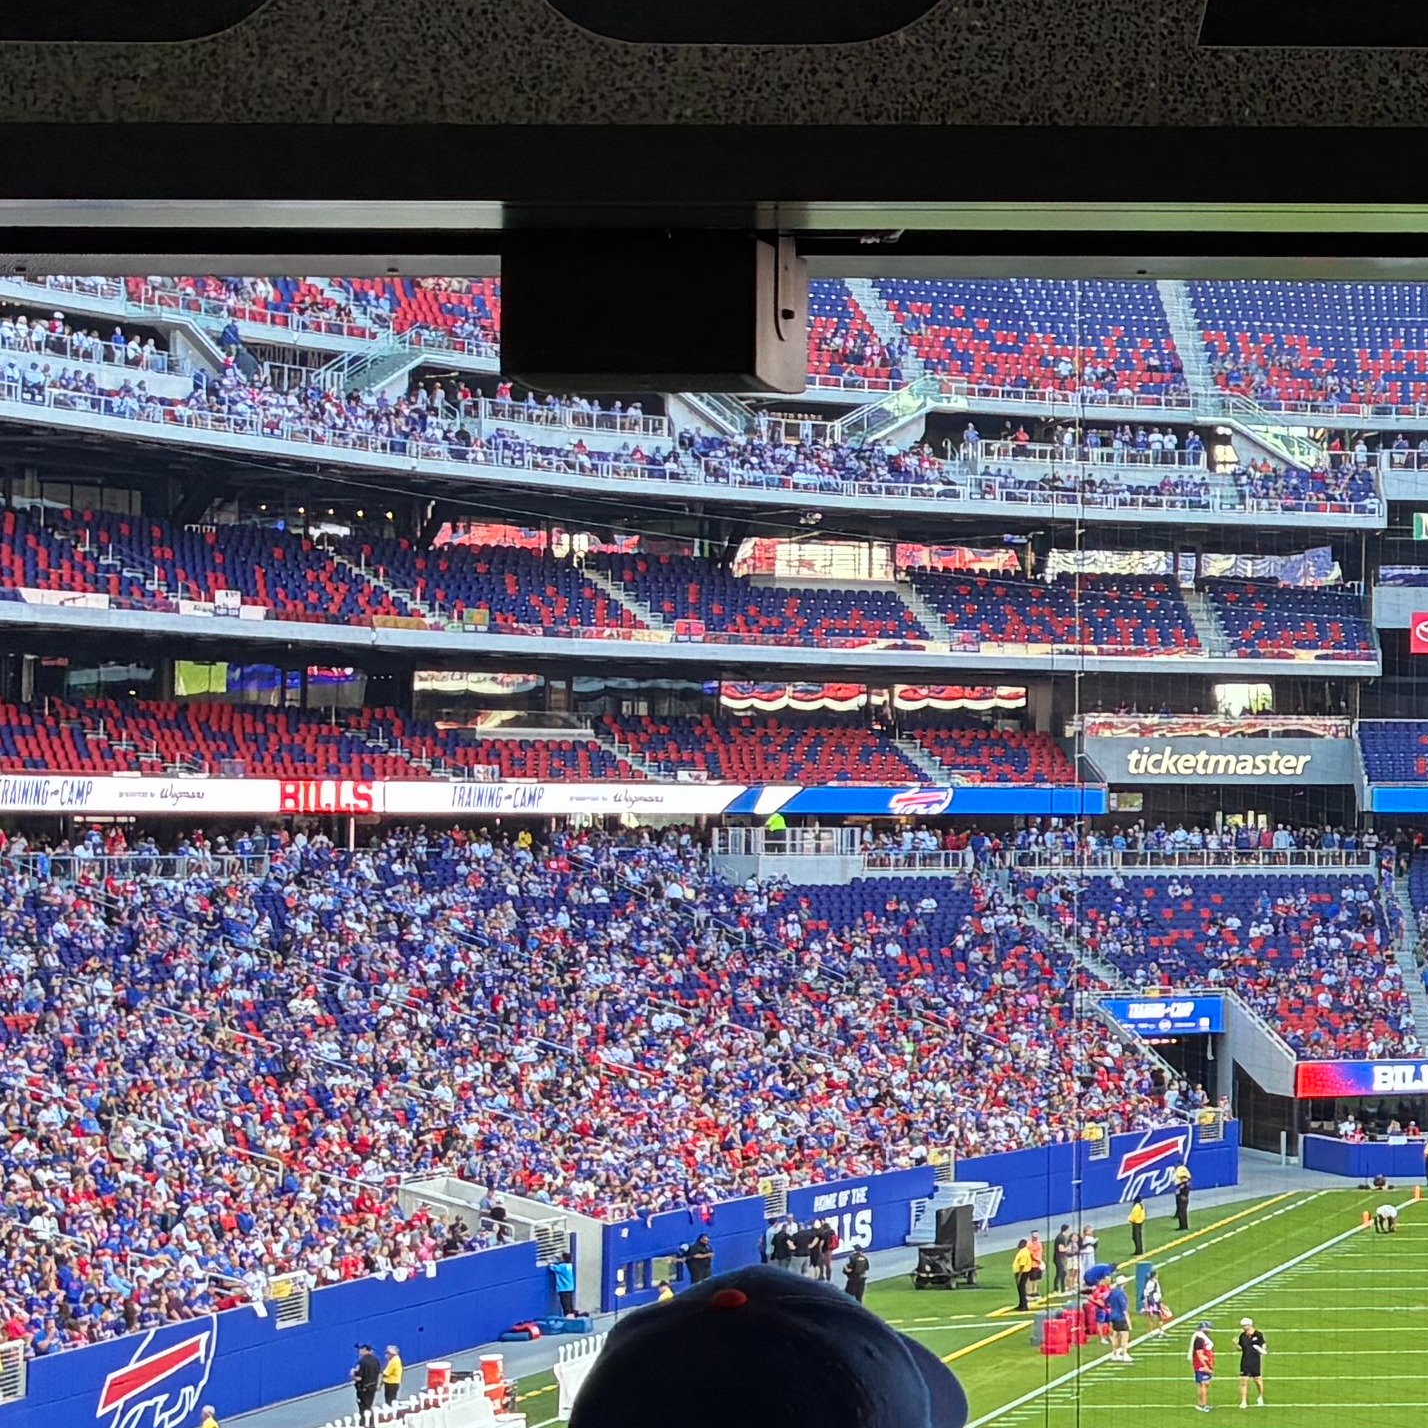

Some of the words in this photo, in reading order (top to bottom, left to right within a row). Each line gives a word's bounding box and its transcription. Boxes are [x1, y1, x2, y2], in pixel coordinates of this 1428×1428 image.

[1126, 746, 1311, 776] ticketmaster
[0, 780, 49, 807] RAINING
[60, 780, 93, 807] CAMP
[279, 780, 374, 812] BILLS
[452, 786, 503, 809] TRAINING
[513, 786, 544, 809] CAMP
